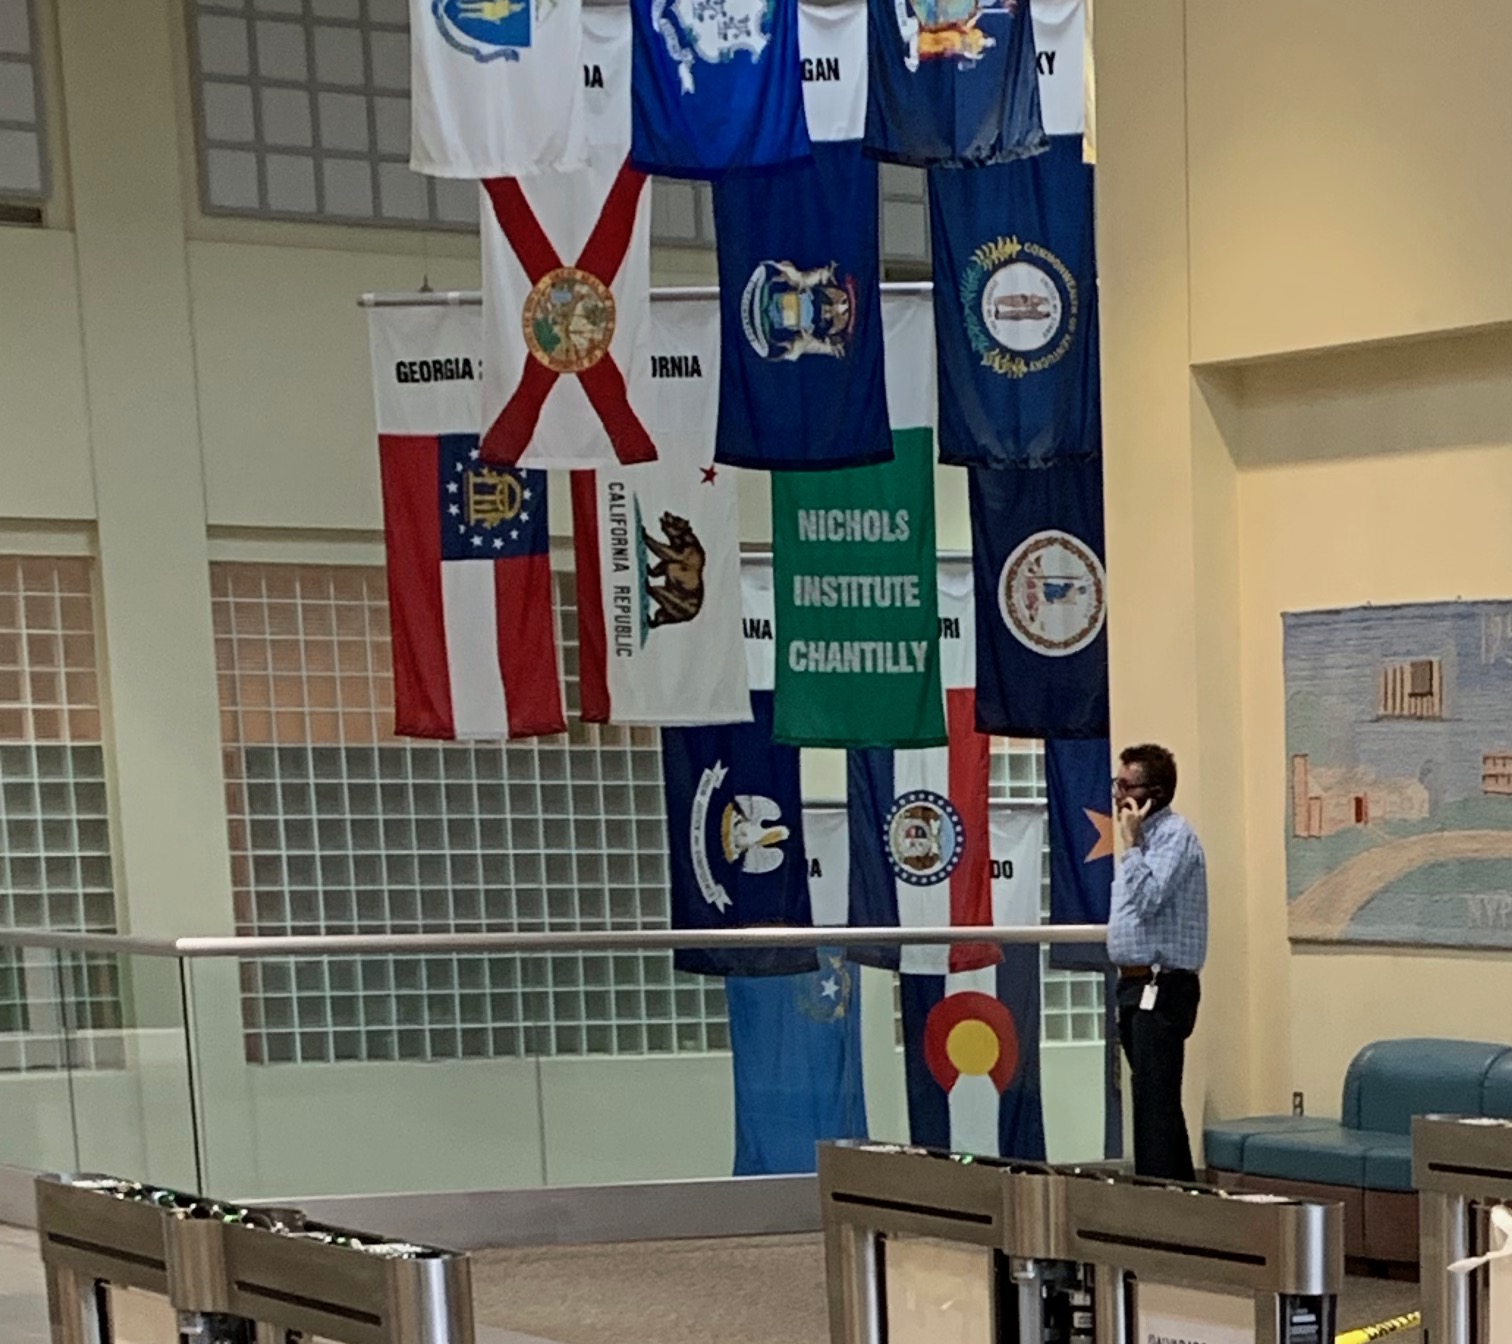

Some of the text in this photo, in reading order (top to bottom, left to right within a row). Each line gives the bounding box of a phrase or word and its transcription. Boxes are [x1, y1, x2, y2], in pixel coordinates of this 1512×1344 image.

[395, 358, 474, 383] GEORGIA
[797, 509, 911, 542] NICHOLS
[608, 482, 632, 657] CALIFORNIA REPUBLIC
[793, 575, 921, 608] INSTITUTE
[788, 640, 928, 673] CHANTILLY
